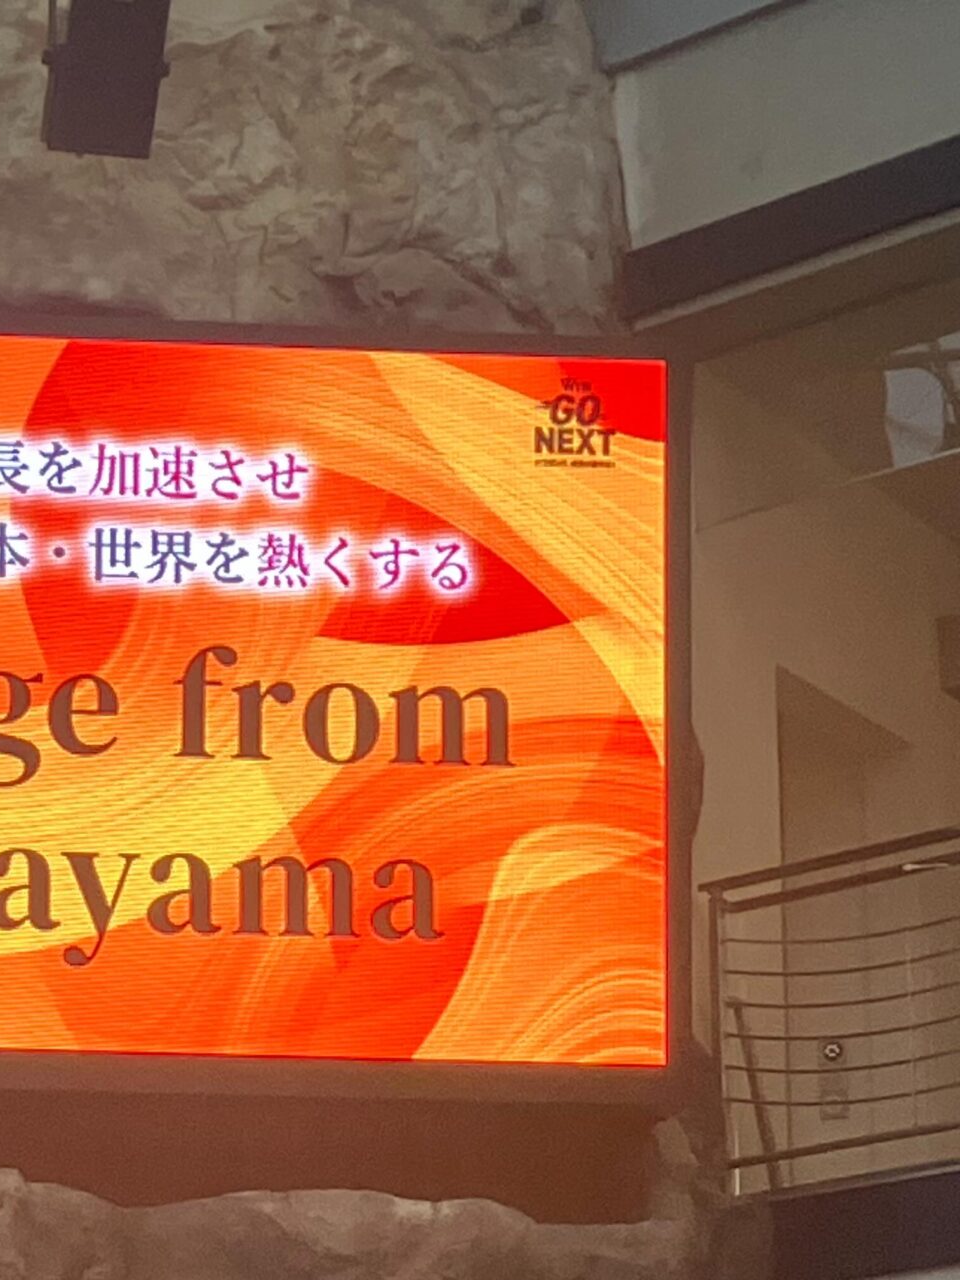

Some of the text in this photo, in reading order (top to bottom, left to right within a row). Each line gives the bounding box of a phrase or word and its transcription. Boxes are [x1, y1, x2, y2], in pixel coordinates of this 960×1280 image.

[549, 394, 601, 426] GO
[534, 427, 616, 456] NEXT
[175, 645, 517, 768] from
